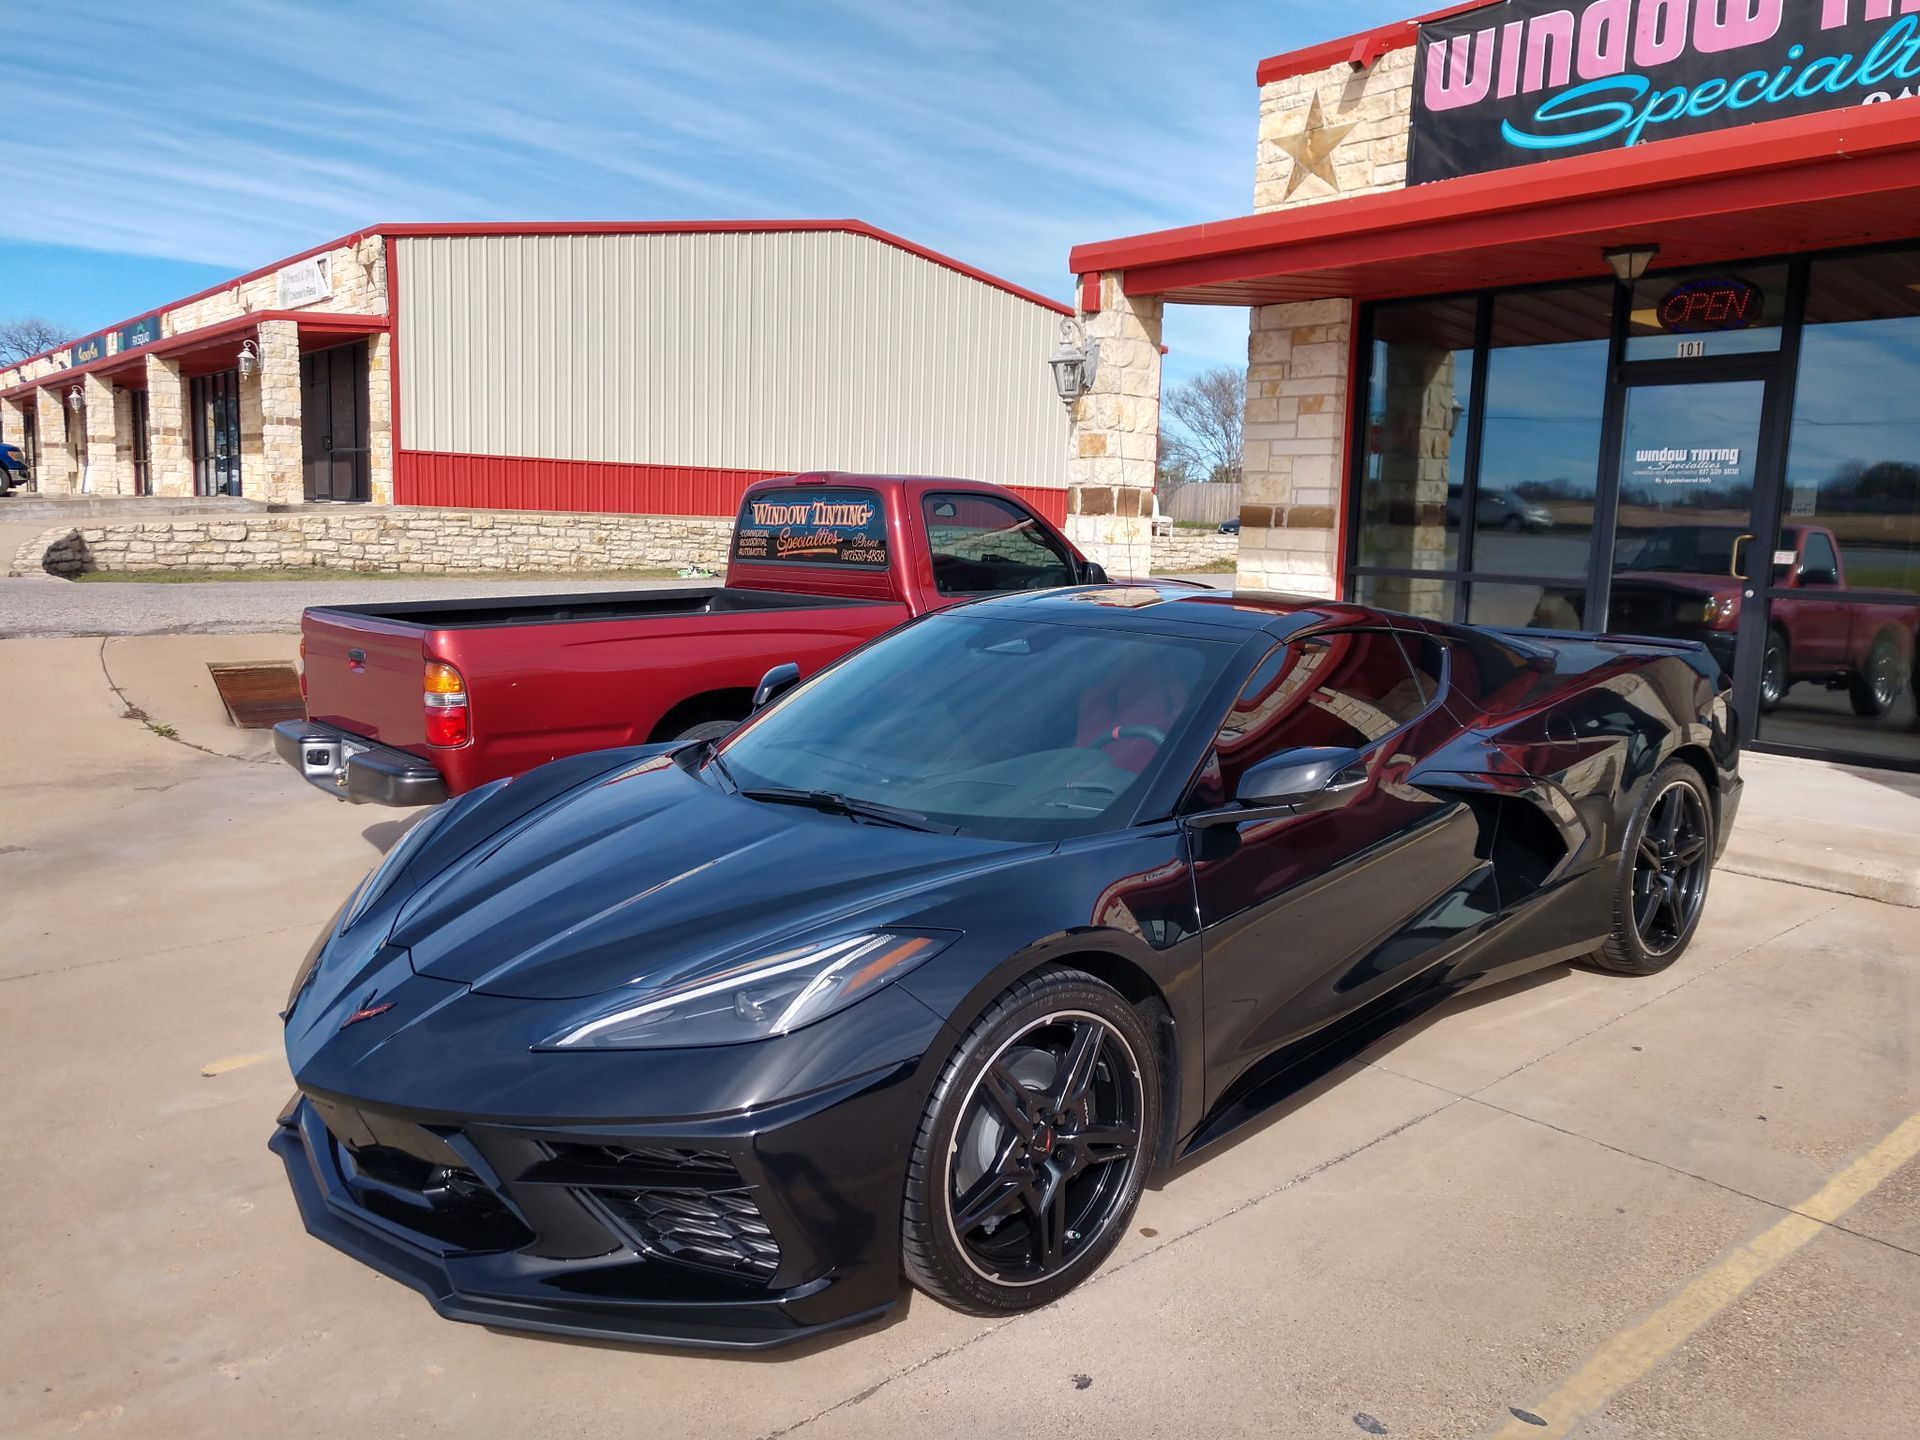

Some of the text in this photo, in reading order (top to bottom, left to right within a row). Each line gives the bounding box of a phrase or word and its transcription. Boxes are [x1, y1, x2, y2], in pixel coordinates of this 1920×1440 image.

[1664, 289, 1751, 323] OPEN
[1680, 341, 1701, 357] 101
[1648, 460, 1721, 471] Specialties
[752, 501, 873, 527] WINDOW TINTING
[776, 527, 843, 556] Specialties
[851, 533, 880, 548] Phone
